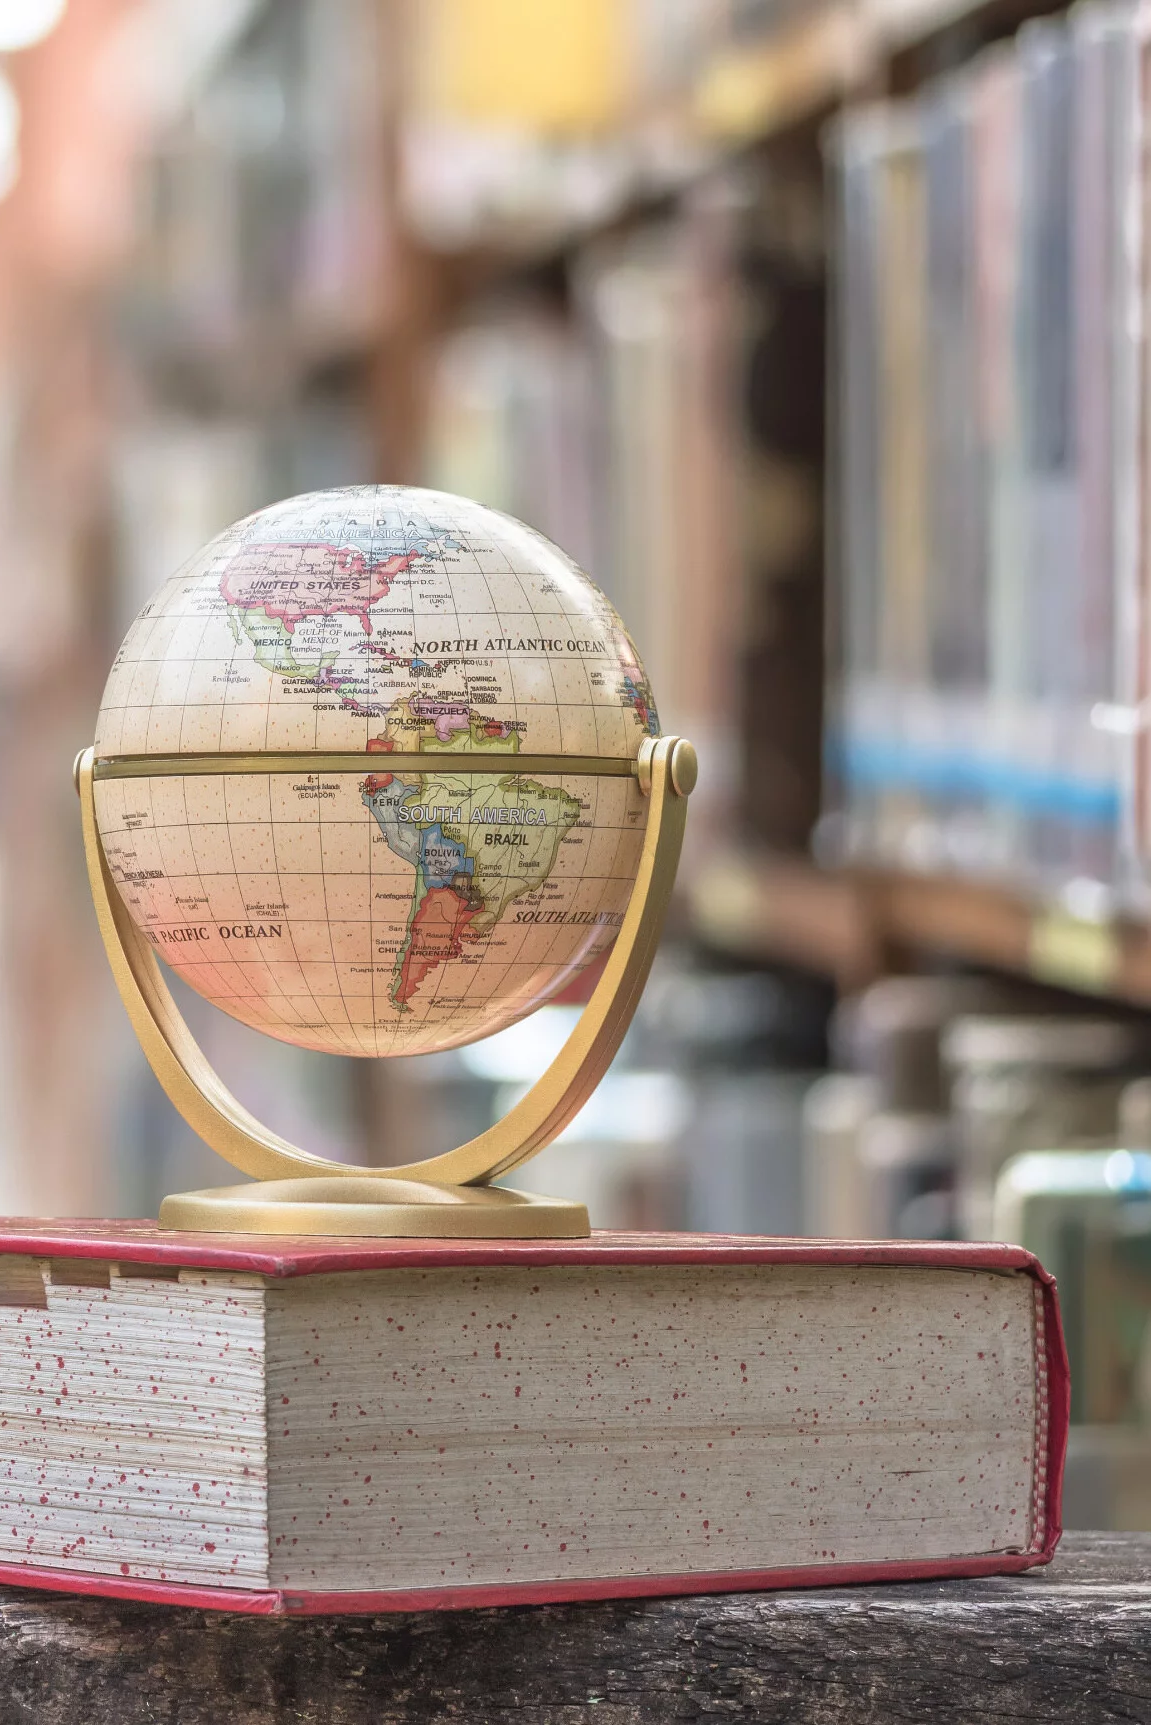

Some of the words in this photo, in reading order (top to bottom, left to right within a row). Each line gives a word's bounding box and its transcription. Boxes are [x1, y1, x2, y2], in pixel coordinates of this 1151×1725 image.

[250, 580, 300, 590] UNITED
[306, 581, 361, 590] STATES
[375, 579, 420, 587] Washington
[286, 617, 316, 625] Houston
[253, 638, 292, 647] MEXICO
[301, 636, 340, 645] MEXICO
[290, 645, 323, 653] Tampico
[411, 639, 479, 655] NORTH
[484, 638, 563, 652] ATLANTIC
[566, 639, 606, 653] OCEAN
[281, 678, 326, 686] GUATEMALA
[329, 677, 371, 685] HONDURAS
[421, 682, 436, 690] SEA
[293, 687, 333, 695] SALVADOR
[334, 687, 379, 695] NICARAGUA
[413, 706, 469, 716] VENEZUELA
[387, 717, 436, 726] COLOMBIA
[297, 792, 336, 800] (ECUADOR)
[372, 798, 400, 807] PERU
[398, 805, 462, 823] SOUTH
[469, 807, 548, 825] AMERICA
[372, 835, 389, 843] Lima
[484, 833, 530, 846] BRAZIL
[424, 848, 462, 857] BOLIVIA
[478, 863, 503, 871] Campo
[512, 911, 568, 923] SOUTH
[160, 927, 210, 943] PACIFIC
[219, 924, 282, 939] OCEAN
[350, 966, 375, 974] Puerto
